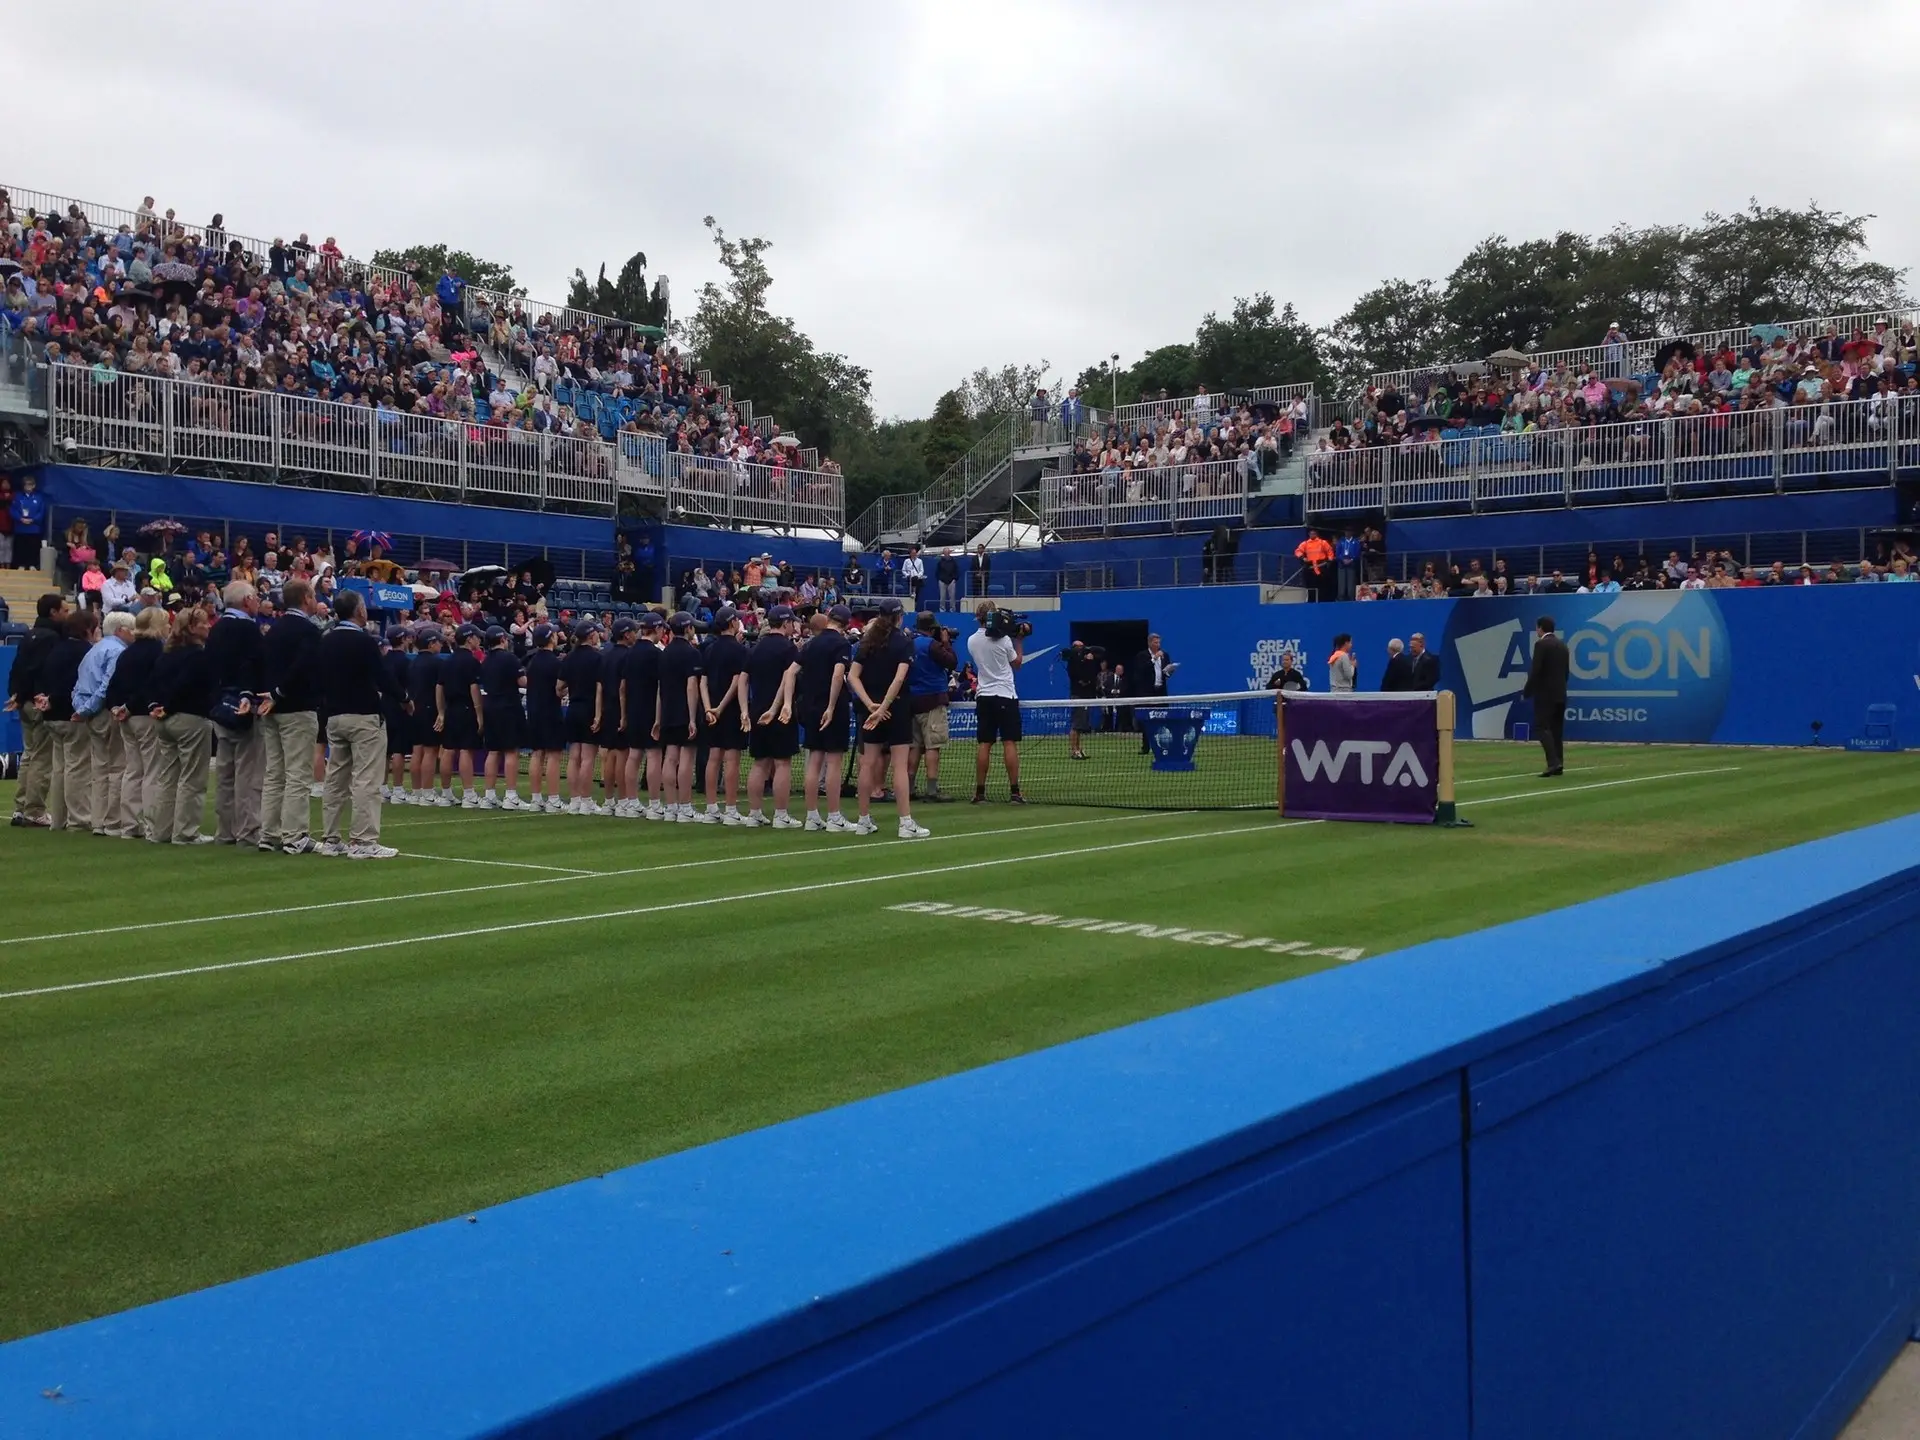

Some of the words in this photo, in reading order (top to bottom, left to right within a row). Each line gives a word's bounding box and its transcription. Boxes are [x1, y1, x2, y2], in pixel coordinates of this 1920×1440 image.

[1256, 639, 1301, 652] GREAT
[1250, 652, 1307, 665] BRITSH
[1253, 665, 1304, 678] TENS
[1563, 707, 1648, 722] CLASSIC
[1291, 738, 1429, 788] WTA
